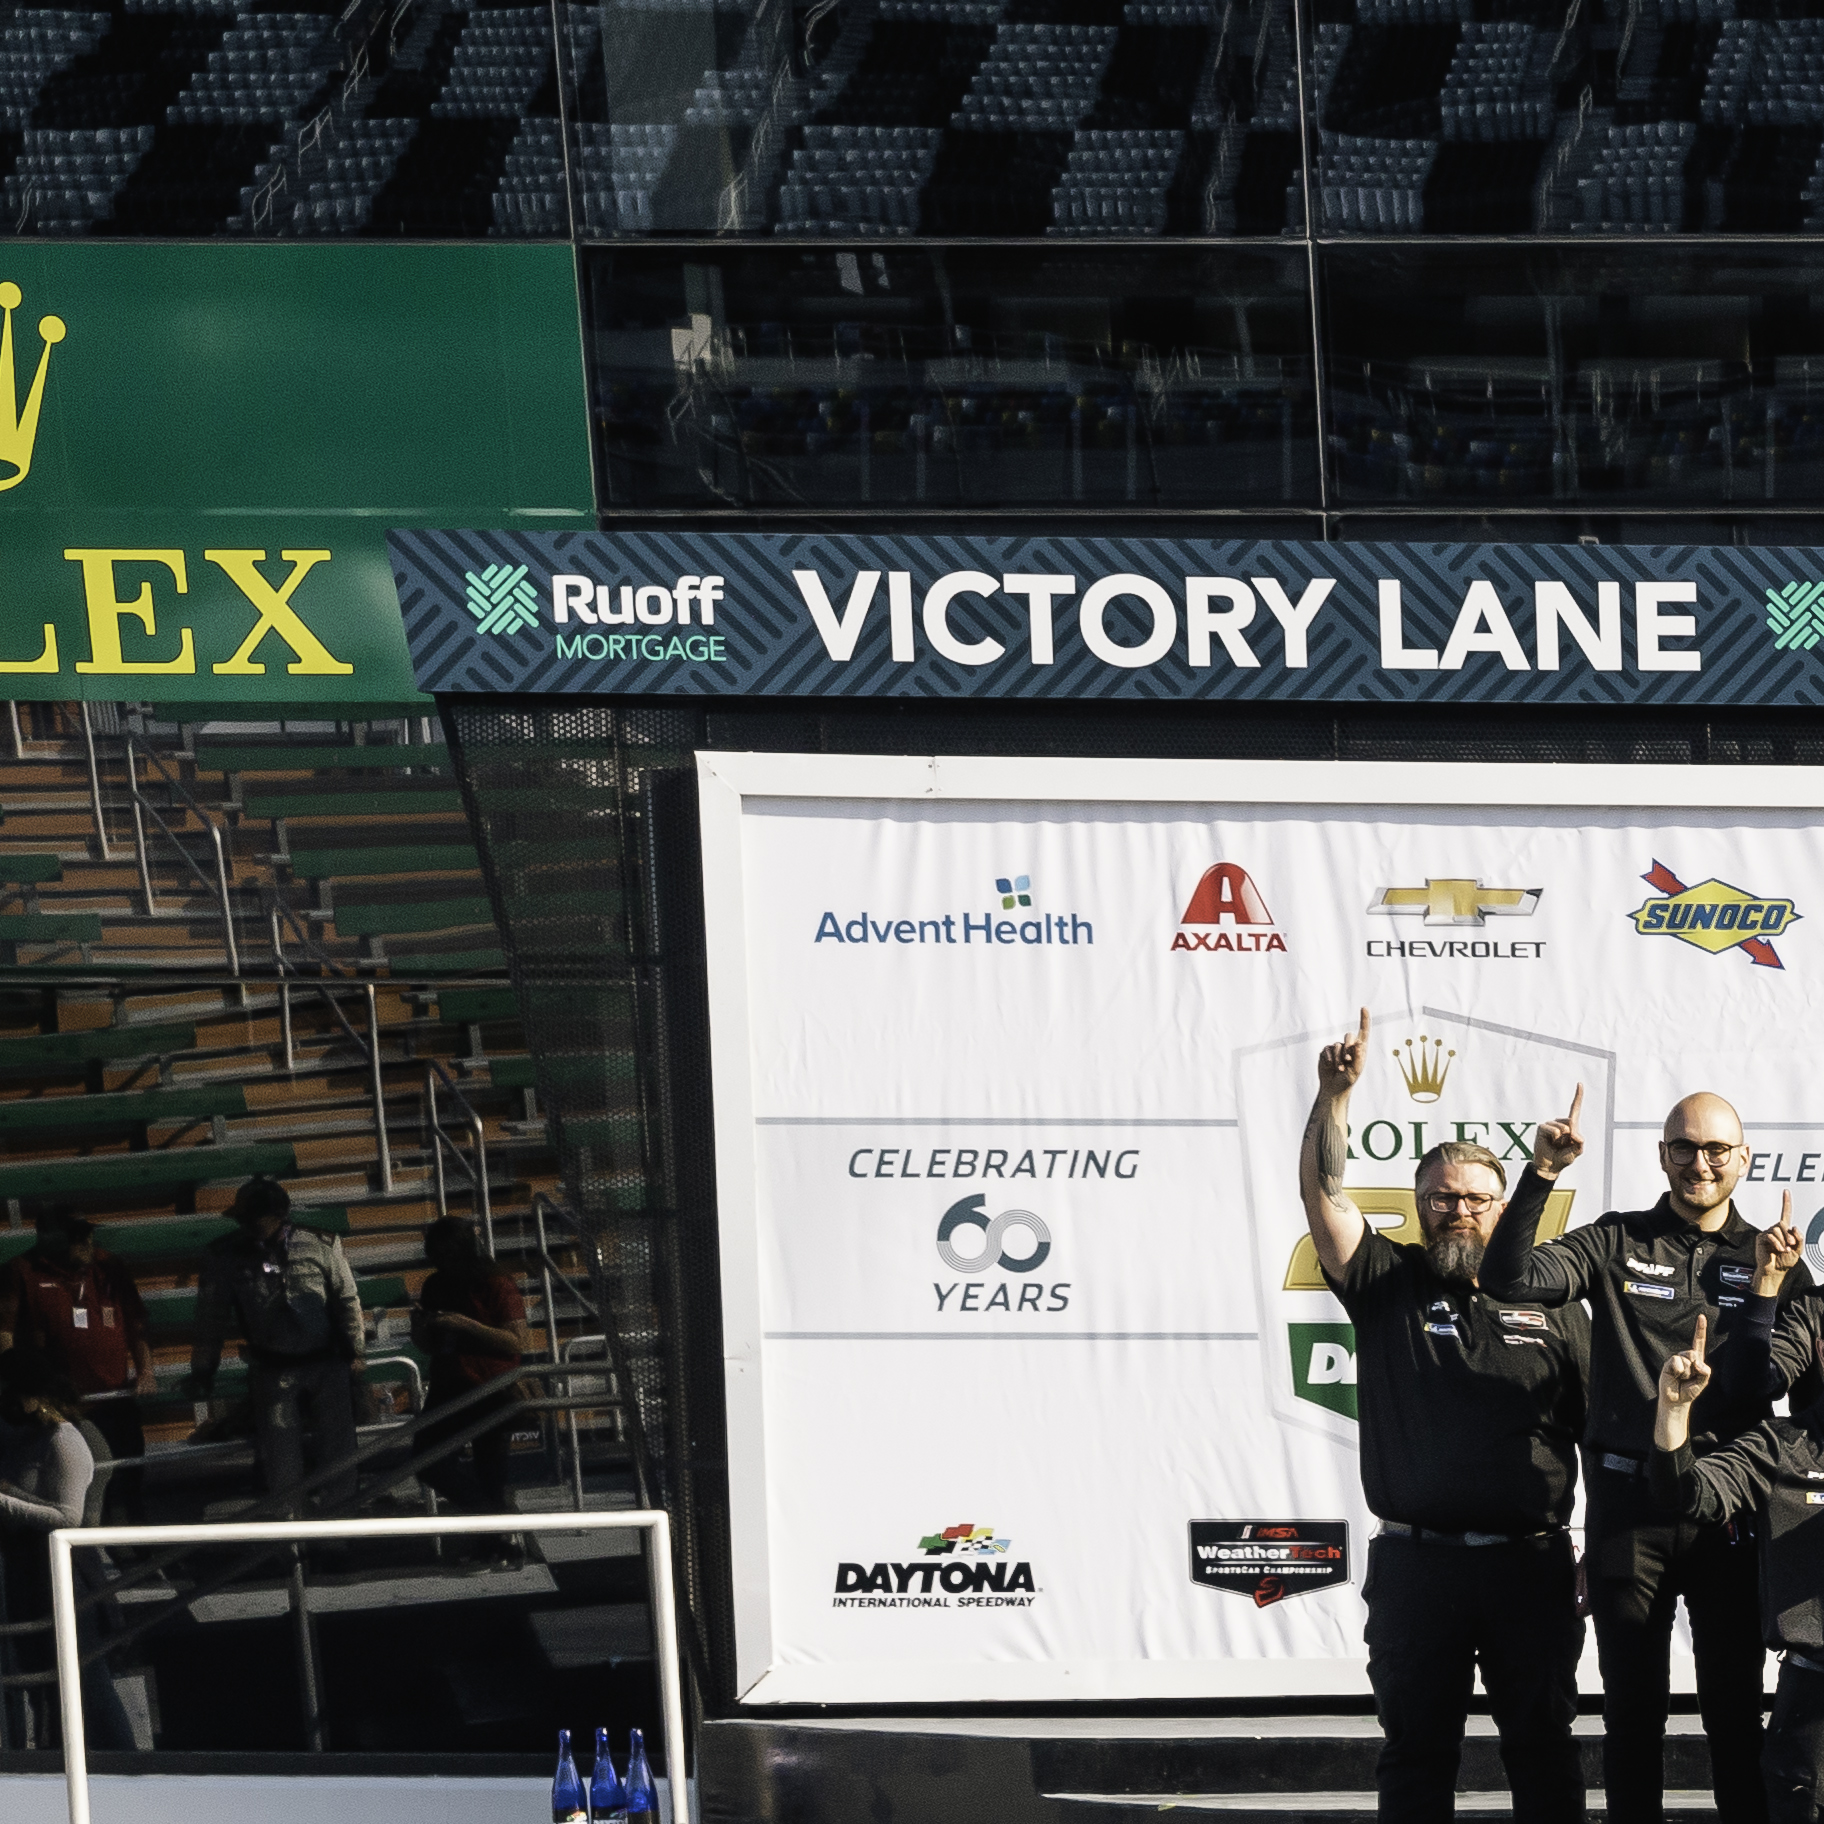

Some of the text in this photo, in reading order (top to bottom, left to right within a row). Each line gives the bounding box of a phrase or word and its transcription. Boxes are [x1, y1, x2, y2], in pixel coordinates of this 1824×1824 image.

[553, 575, 727, 627] Ruoff
[793, 570, 1703, 673] VICTORY LANE
[556, 633, 727, 663] MORTGAGE
[1638, 901, 1792, 933] SUNOCO
[1170, 931, 1287, 953] AXALTA
[1366, 940, 1546, 959] CHEVROLET
[1345, 1119, 1537, 1162] OLEX
[848, 1148, 1141, 1180] CELEBRATING
[936, 1192, 1052, 1274] 60
[932, 1282, 1072, 1313] YEARS
[1197, 1545, 1341, 1560] WeatherTech
[834, 1561, 1037, 1594] DAYTONA
[832, 1596, 1036, 1608] INTERNATIONAL SPEEDWAY
